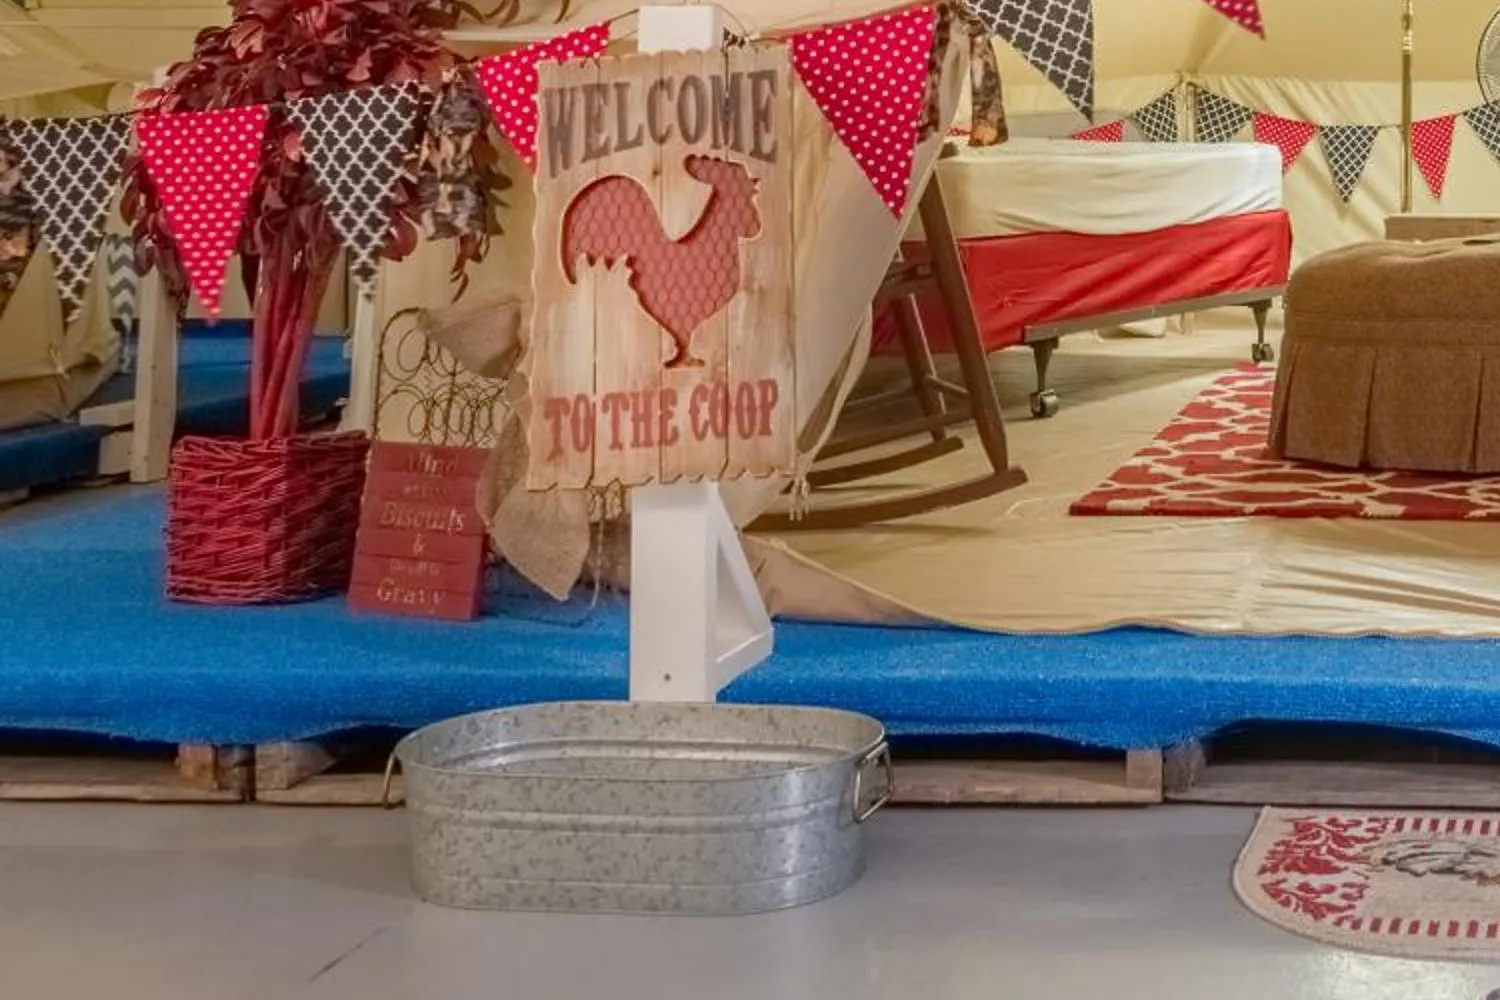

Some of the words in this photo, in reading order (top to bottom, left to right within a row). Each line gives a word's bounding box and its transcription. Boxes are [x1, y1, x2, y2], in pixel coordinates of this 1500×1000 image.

[541, 69, 779, 180] WELCOME
[544, 394, 592, 461] TO
[602, 386, 679, 451] THE
[688, 378, 779, 441] COOP
